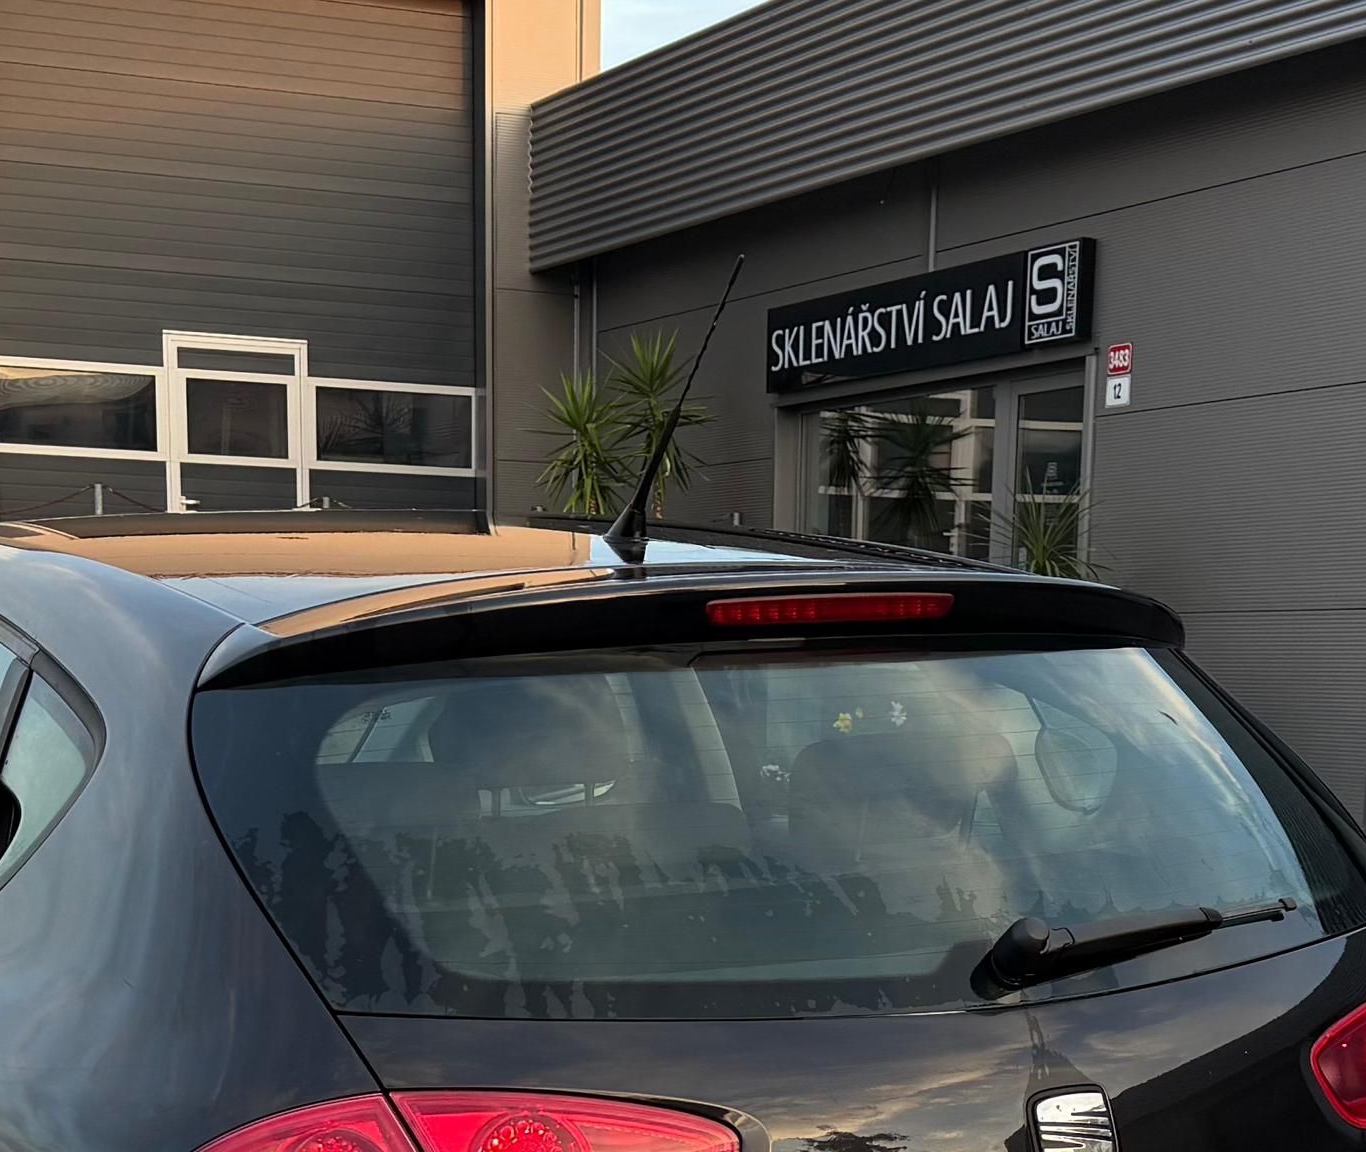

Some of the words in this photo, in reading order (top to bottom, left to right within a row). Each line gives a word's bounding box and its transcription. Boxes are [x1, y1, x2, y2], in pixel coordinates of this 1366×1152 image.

[1030, 253, 1064, 315] S
[771, 290, 927, 372] SKLENÁŘSTVÍ
[931, 280, 1014, 342] SALAJ
[1031, 321, 1063, 339] SALAJ
[1109, 349, 1130, 369] 3483
[1114, 383, 1121, 399] 12
